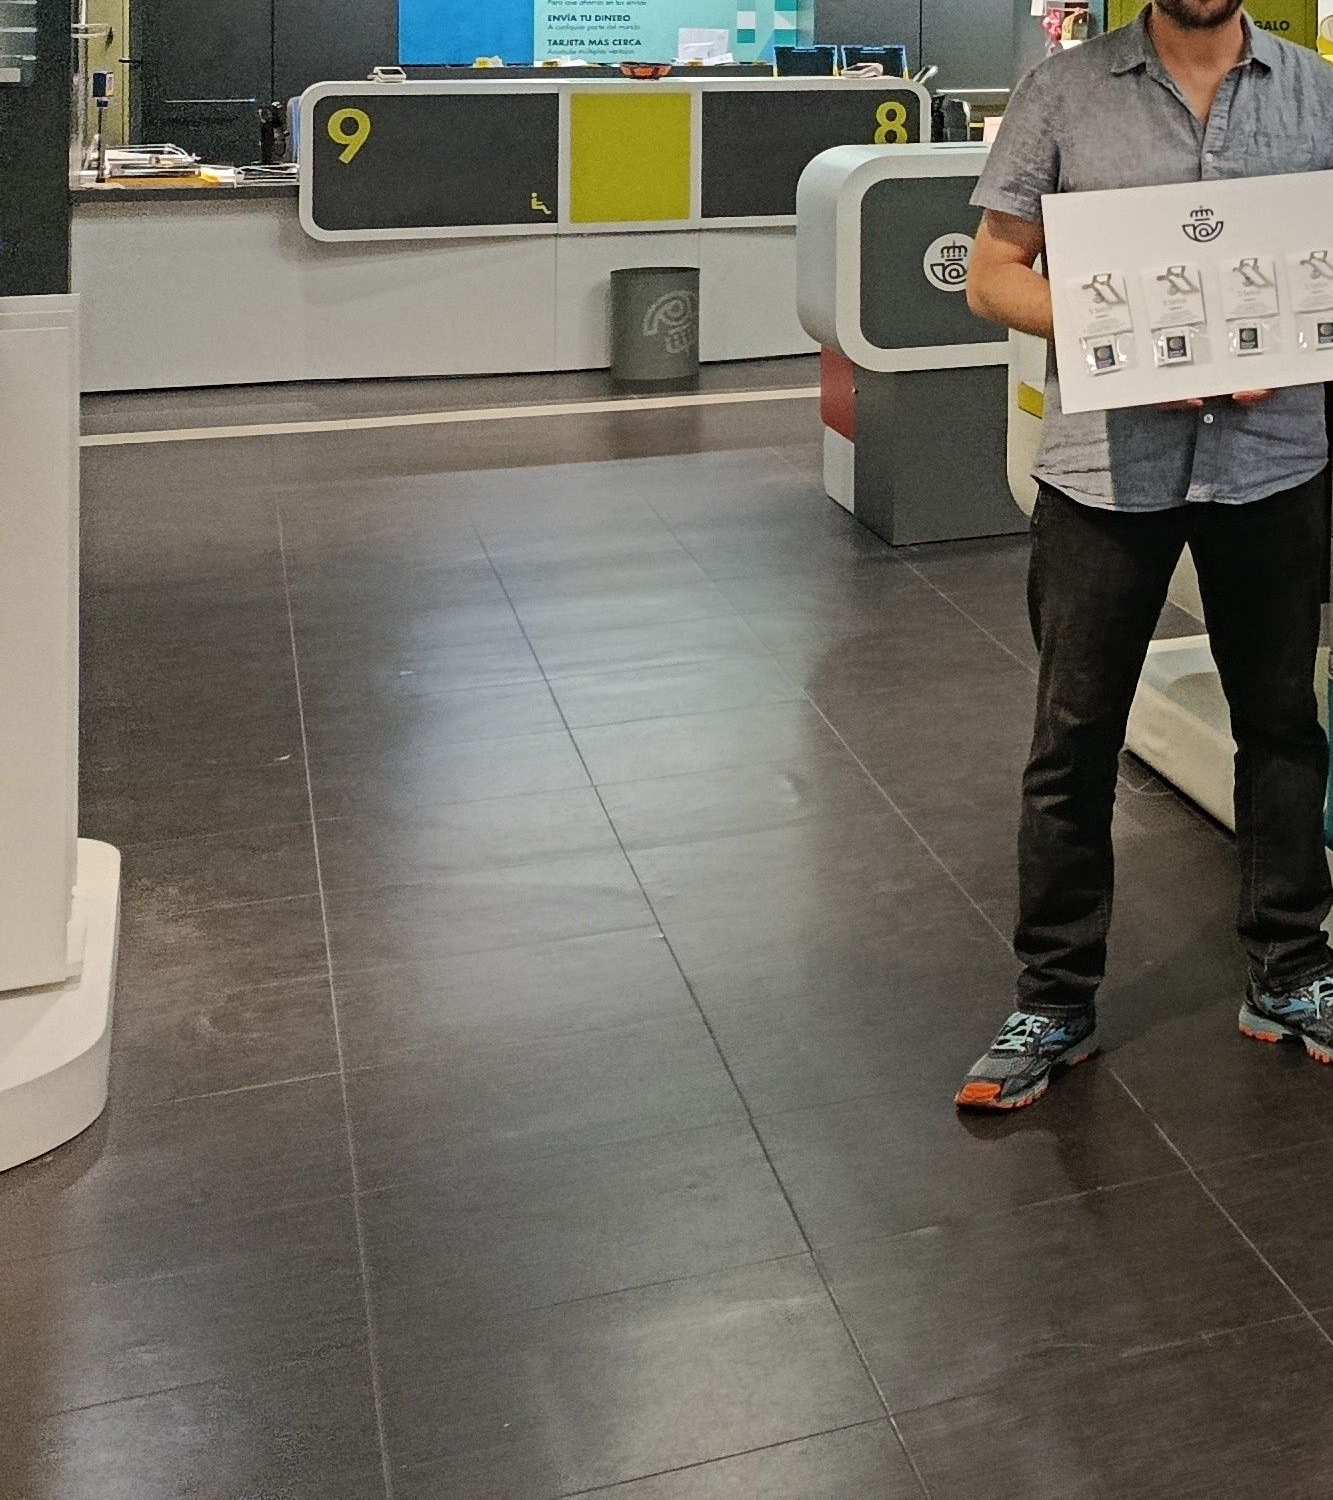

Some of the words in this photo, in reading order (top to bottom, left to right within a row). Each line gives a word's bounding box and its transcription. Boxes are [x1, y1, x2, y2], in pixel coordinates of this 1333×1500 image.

[548, 13, 577, 21] ENVÍA
[1253, 20, 1290, 32] GALO
[328, 108, 371, 164] 9
[874, 101, 908, 144] 8
